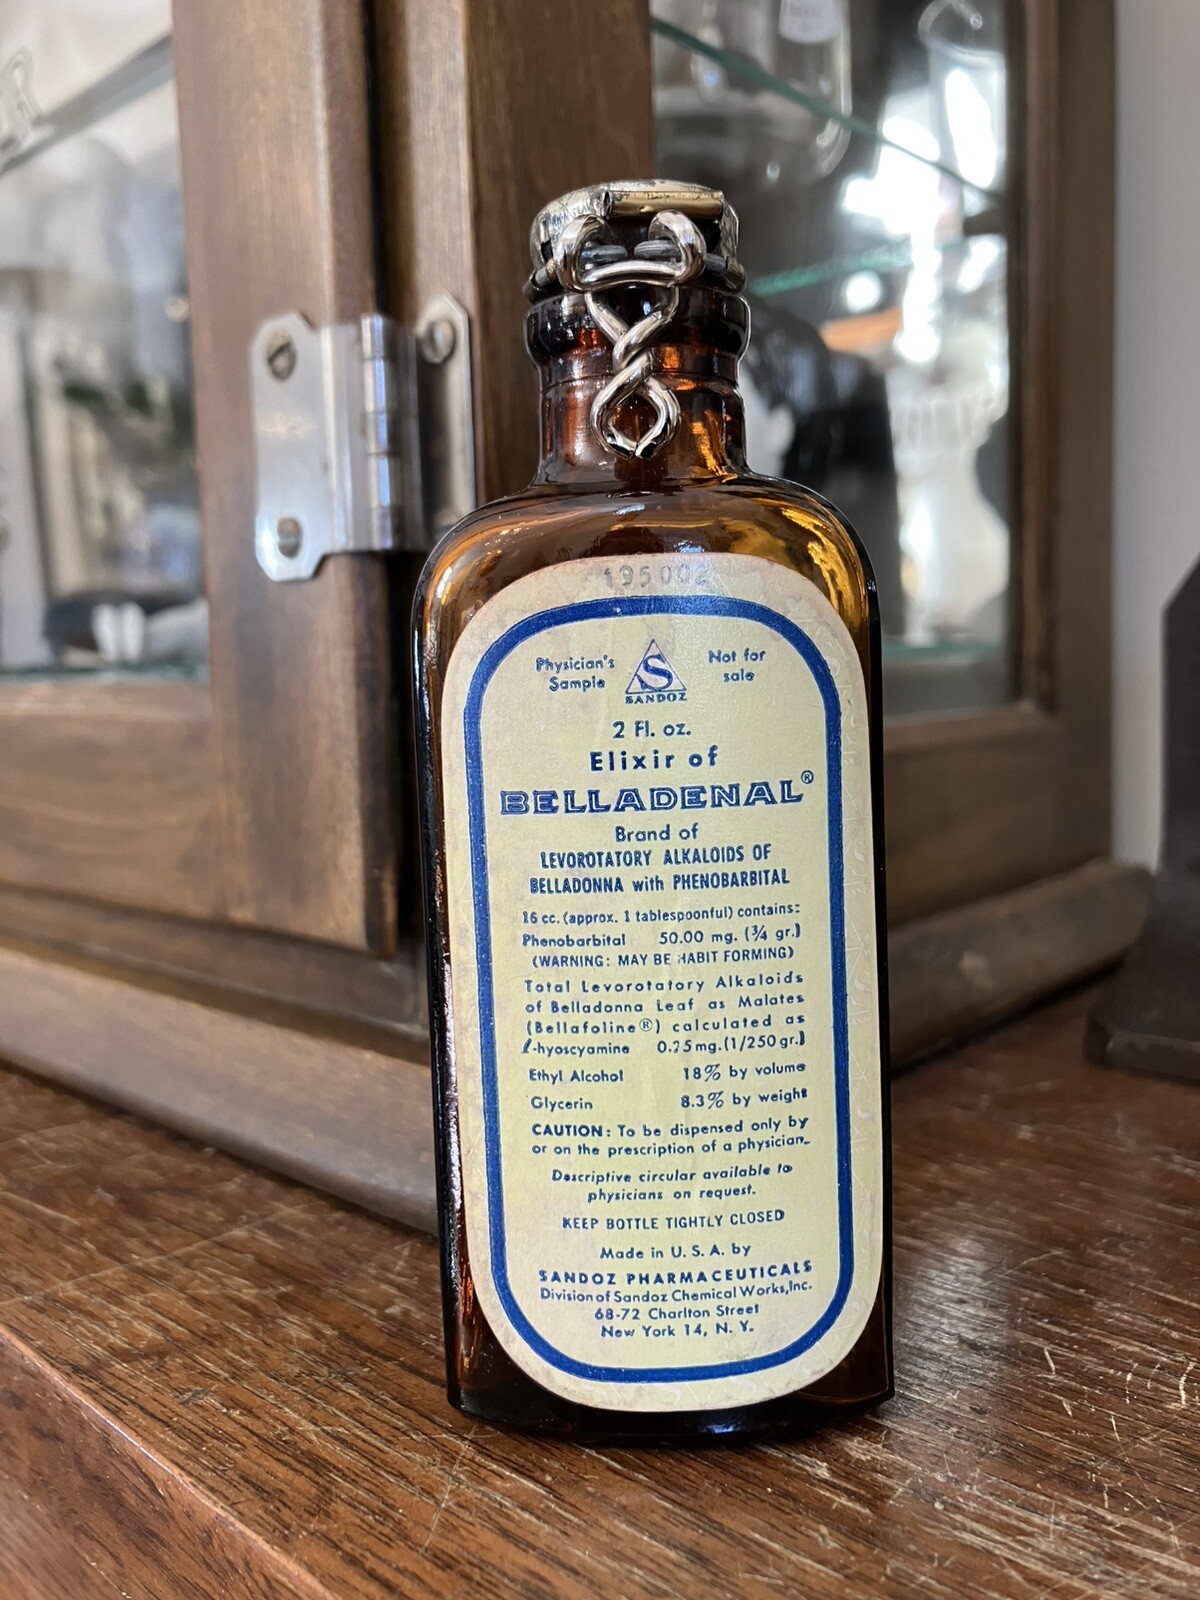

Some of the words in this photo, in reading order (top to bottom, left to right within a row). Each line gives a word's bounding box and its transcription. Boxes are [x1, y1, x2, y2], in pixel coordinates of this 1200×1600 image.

[535, 654, 615, 675] Physician's
[708, 649, 737, 664] Not
[743, 647, 767, 662] for
[548, 674, 606, 693] Sample
[723, 667, 755, 683] sale
[625, 692, 688, 705] SANDOZ
[612, 720, 626, 739] 2
[634, 719, 656, 738] Fl.
[662, 722, 692, 737] oz.
[589, 748, 675, 772] Elixir
[688, 744, 719, 768] of
[614, 823, 671, 843] Brand
[678, 821, 699, 841] of
[540, 849, 653, 870] LEVOROTATORY
[663, 844, 745, 866] ALKALOIDS
[752, 842, 772, 862] OF
[529, 876, 625, 895] BELLADONNA
[631, 874, 665, 893] with
[672, 867, 791, 891] PHENOBARBITAL
[522, 910, 539, 925] 16
[541, 913, 560, 925] cc.
[562, 910, 619, 927] (approx.
[623, 909, 631, 923] 1
[635, 905, 734, 923] tablespoonful)
[737, 902, 801, 918] contains:
[522, 932, 626, 948] Phenobarbital
[658, 929, 704, 945] 50.00
[711, 932, 738, 945] mg.
[775, 922, 801, 942] gr.)
[531, 954, 611, 969] (WARNING:
[617, 953, 649, 967] MAY
[653, 952, 672, 966] BE
[677, 950, 719, 965] HABIT
[723, 945, 794, 963] FORMING)
[523, 979, 570, 994] Total
[581, 979, 705, 994] Levorotatory
[715, 970, 804, 989] Alkaloids
[525, 999, 543, 1014] of
[550, 999, 644, 1014] Belladonna
[656, 997, 694, 1012] Leaf
[707, 1000, 726, 1010] as
[737, 993, 805, 1009] Malates
[672, 1013, 772, 1033] calculated
[785, 1014, 806, 1025] as
[656, 1039, 692, 1054] 0.25
[695, 1042, 722, 1055] mg.
[779, 1030, 806, 1050] gr.)
[528, 1067, 563, 1086] Ethyl
[569, 1068, 624, 1083] Alcohol
[683, 1063, 722, 1083] 18%
[728, 1064, 748, 1081] by
[754, 1061, 807, 1076] volume
[530, 1095, 594, 1113] Glycerin
[680, 1090, 725, 1110] 8.3%
[732, 1092, 752, 1108] by
[757, 1086, 808, 1104] weight
[531, 1123, 611, 1138] CAUTION:
[616, 1124, 636, 1138] To
[642, 1123, 662, 1137] be
[669, 1119, 744, 1139] dispensed
[750, 1116, 782, 1133] only
[788, 1114, 809, 1130] by
[531, 1144, 548, 1155] or
[553, 1145, 572, 1155] on
[577, 1142, 600, 1156] the
[607, 1142, 695, 1159] prescription
[701, 1139, 717, 1153] of
[722, 1142, 733, 1152] a
[551, 1168, 632, 1186] Descriptive
[638, 1168, 697, 1183] circular
[702, 1163, 771, 1180] available
[777, 1162, 793, 1174] to
[587, 1187, 664, 1204] physicians
[673, 1190, 692, 1200] on
[699, 1183, 757, 1201] request.
[562, 1216, 600, 1230] KEEP
[605, 1217, 659, 1231] BOTTLE
[665, 1214, 724, 1230] TIGHTLY
[729, 1208, 786, 1226] CLOSED
[599, 1246, 645, 1260] Made
[650, 1246, 664, 1259] in
[670, 1245, 687, 1259] U.
[691, 1244, 705, 1258] S.
[709, 1243, 725, 1257] A.
[731, 1242, 752, 1258] by
[537, 1269, 617, 1285] SANDOZ
[626, 1259, 813, 1286] PHARMACEUTICALS
[540, 1286, 594, 1303] Division
[595, 1289, 611, 1303] of
[613, 1290, 668, 1303] Sandoz
[671, 1285, 737, 1302] Chemical
[594, 1307, 641, 1321] 68-72
[647, 1306, 711, 1321] Charlton
[716, 1303, 760, 1317] Street
[600, 1325, 636, 1339] New
[641, 1324, 676, 1338] York
[684, 1322, 708, 1338] 14,
[715, 1321, 733, 1335] N.
[739, 1319, 755, 1333] Y.
